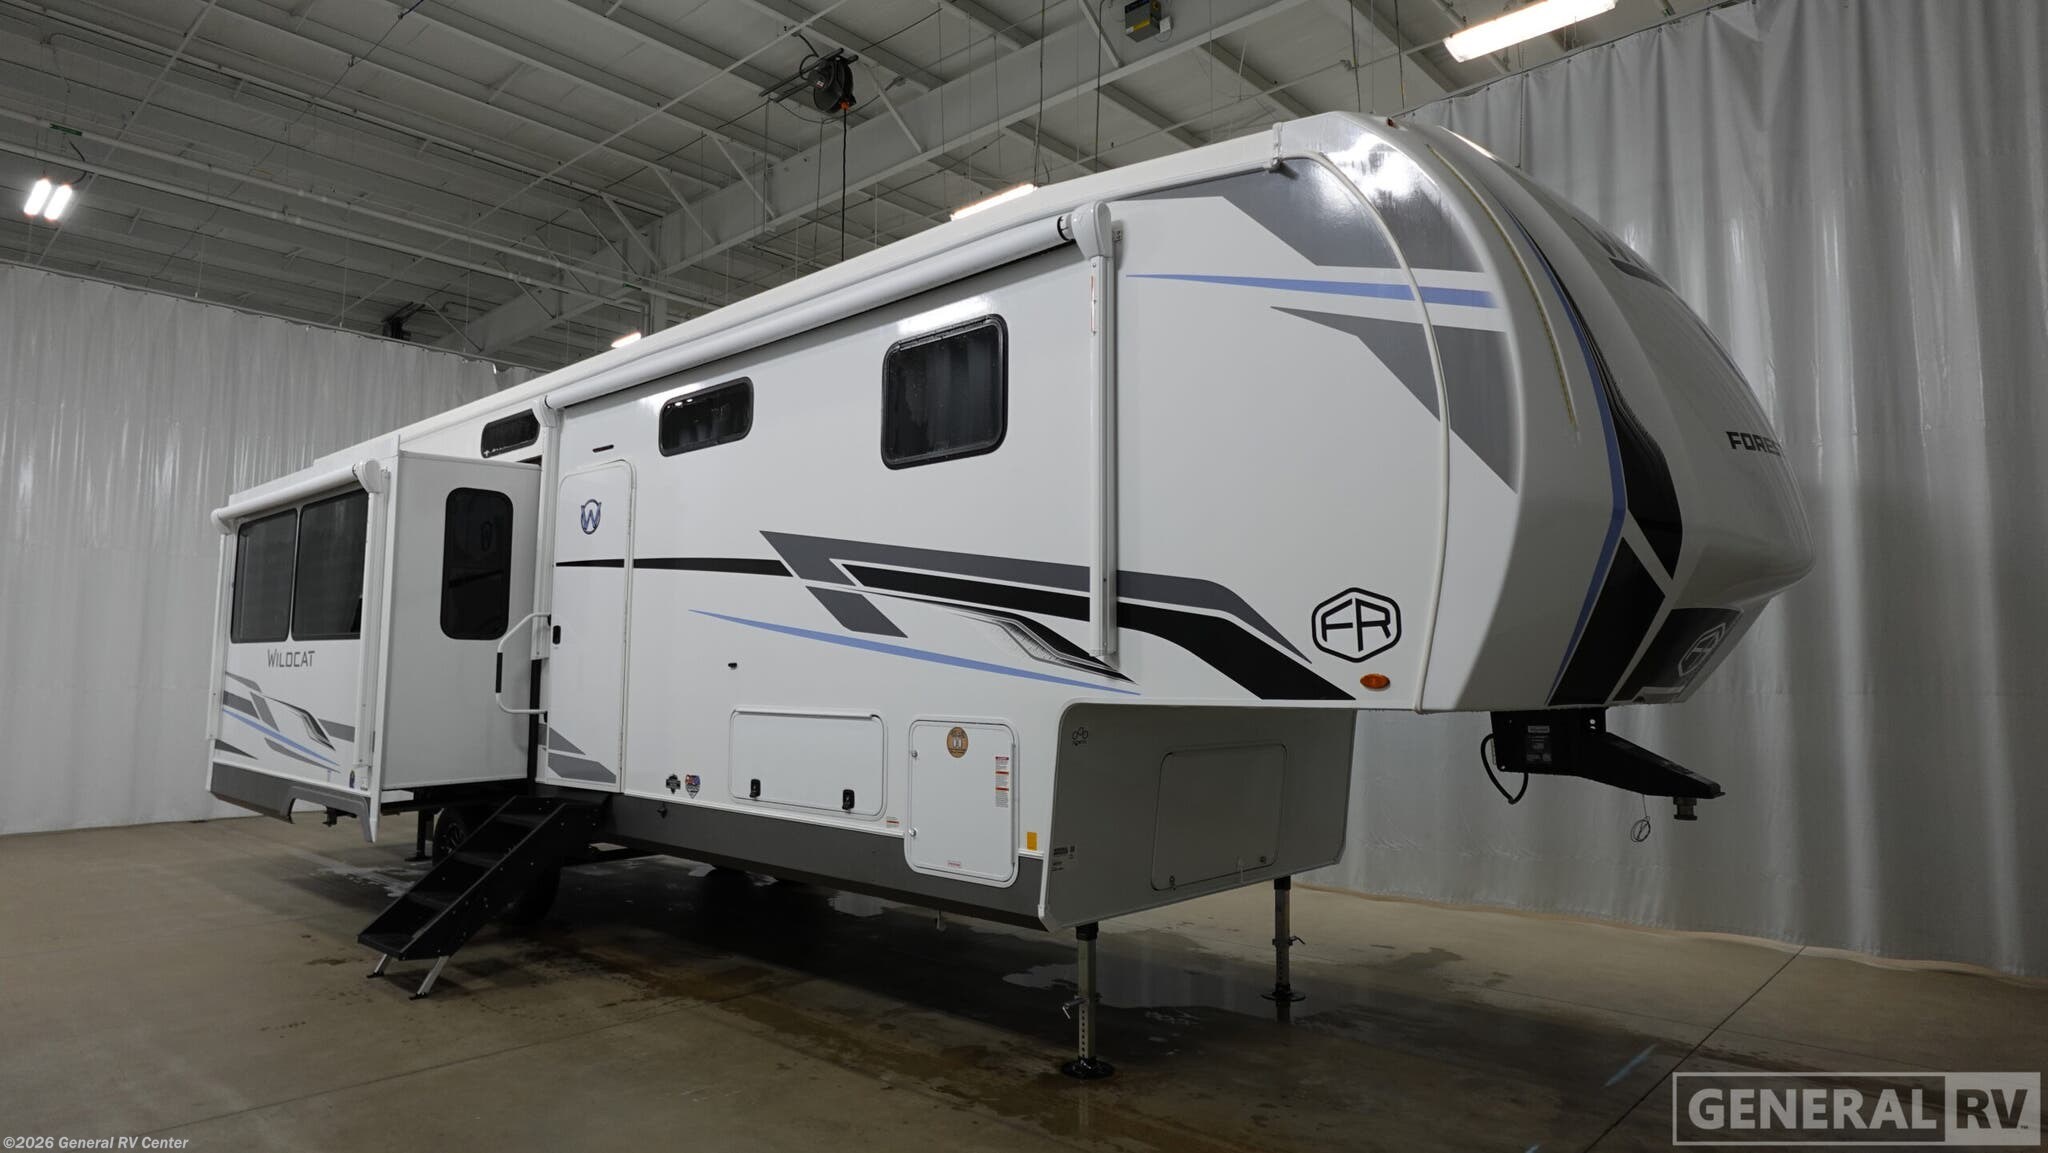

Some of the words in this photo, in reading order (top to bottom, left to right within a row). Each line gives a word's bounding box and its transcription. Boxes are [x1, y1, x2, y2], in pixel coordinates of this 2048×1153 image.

[1726, 431, 1782, 456] FORES
[1320, 597, 1392, 652] FR
[267, 648, 316, 668] WILDCAT
